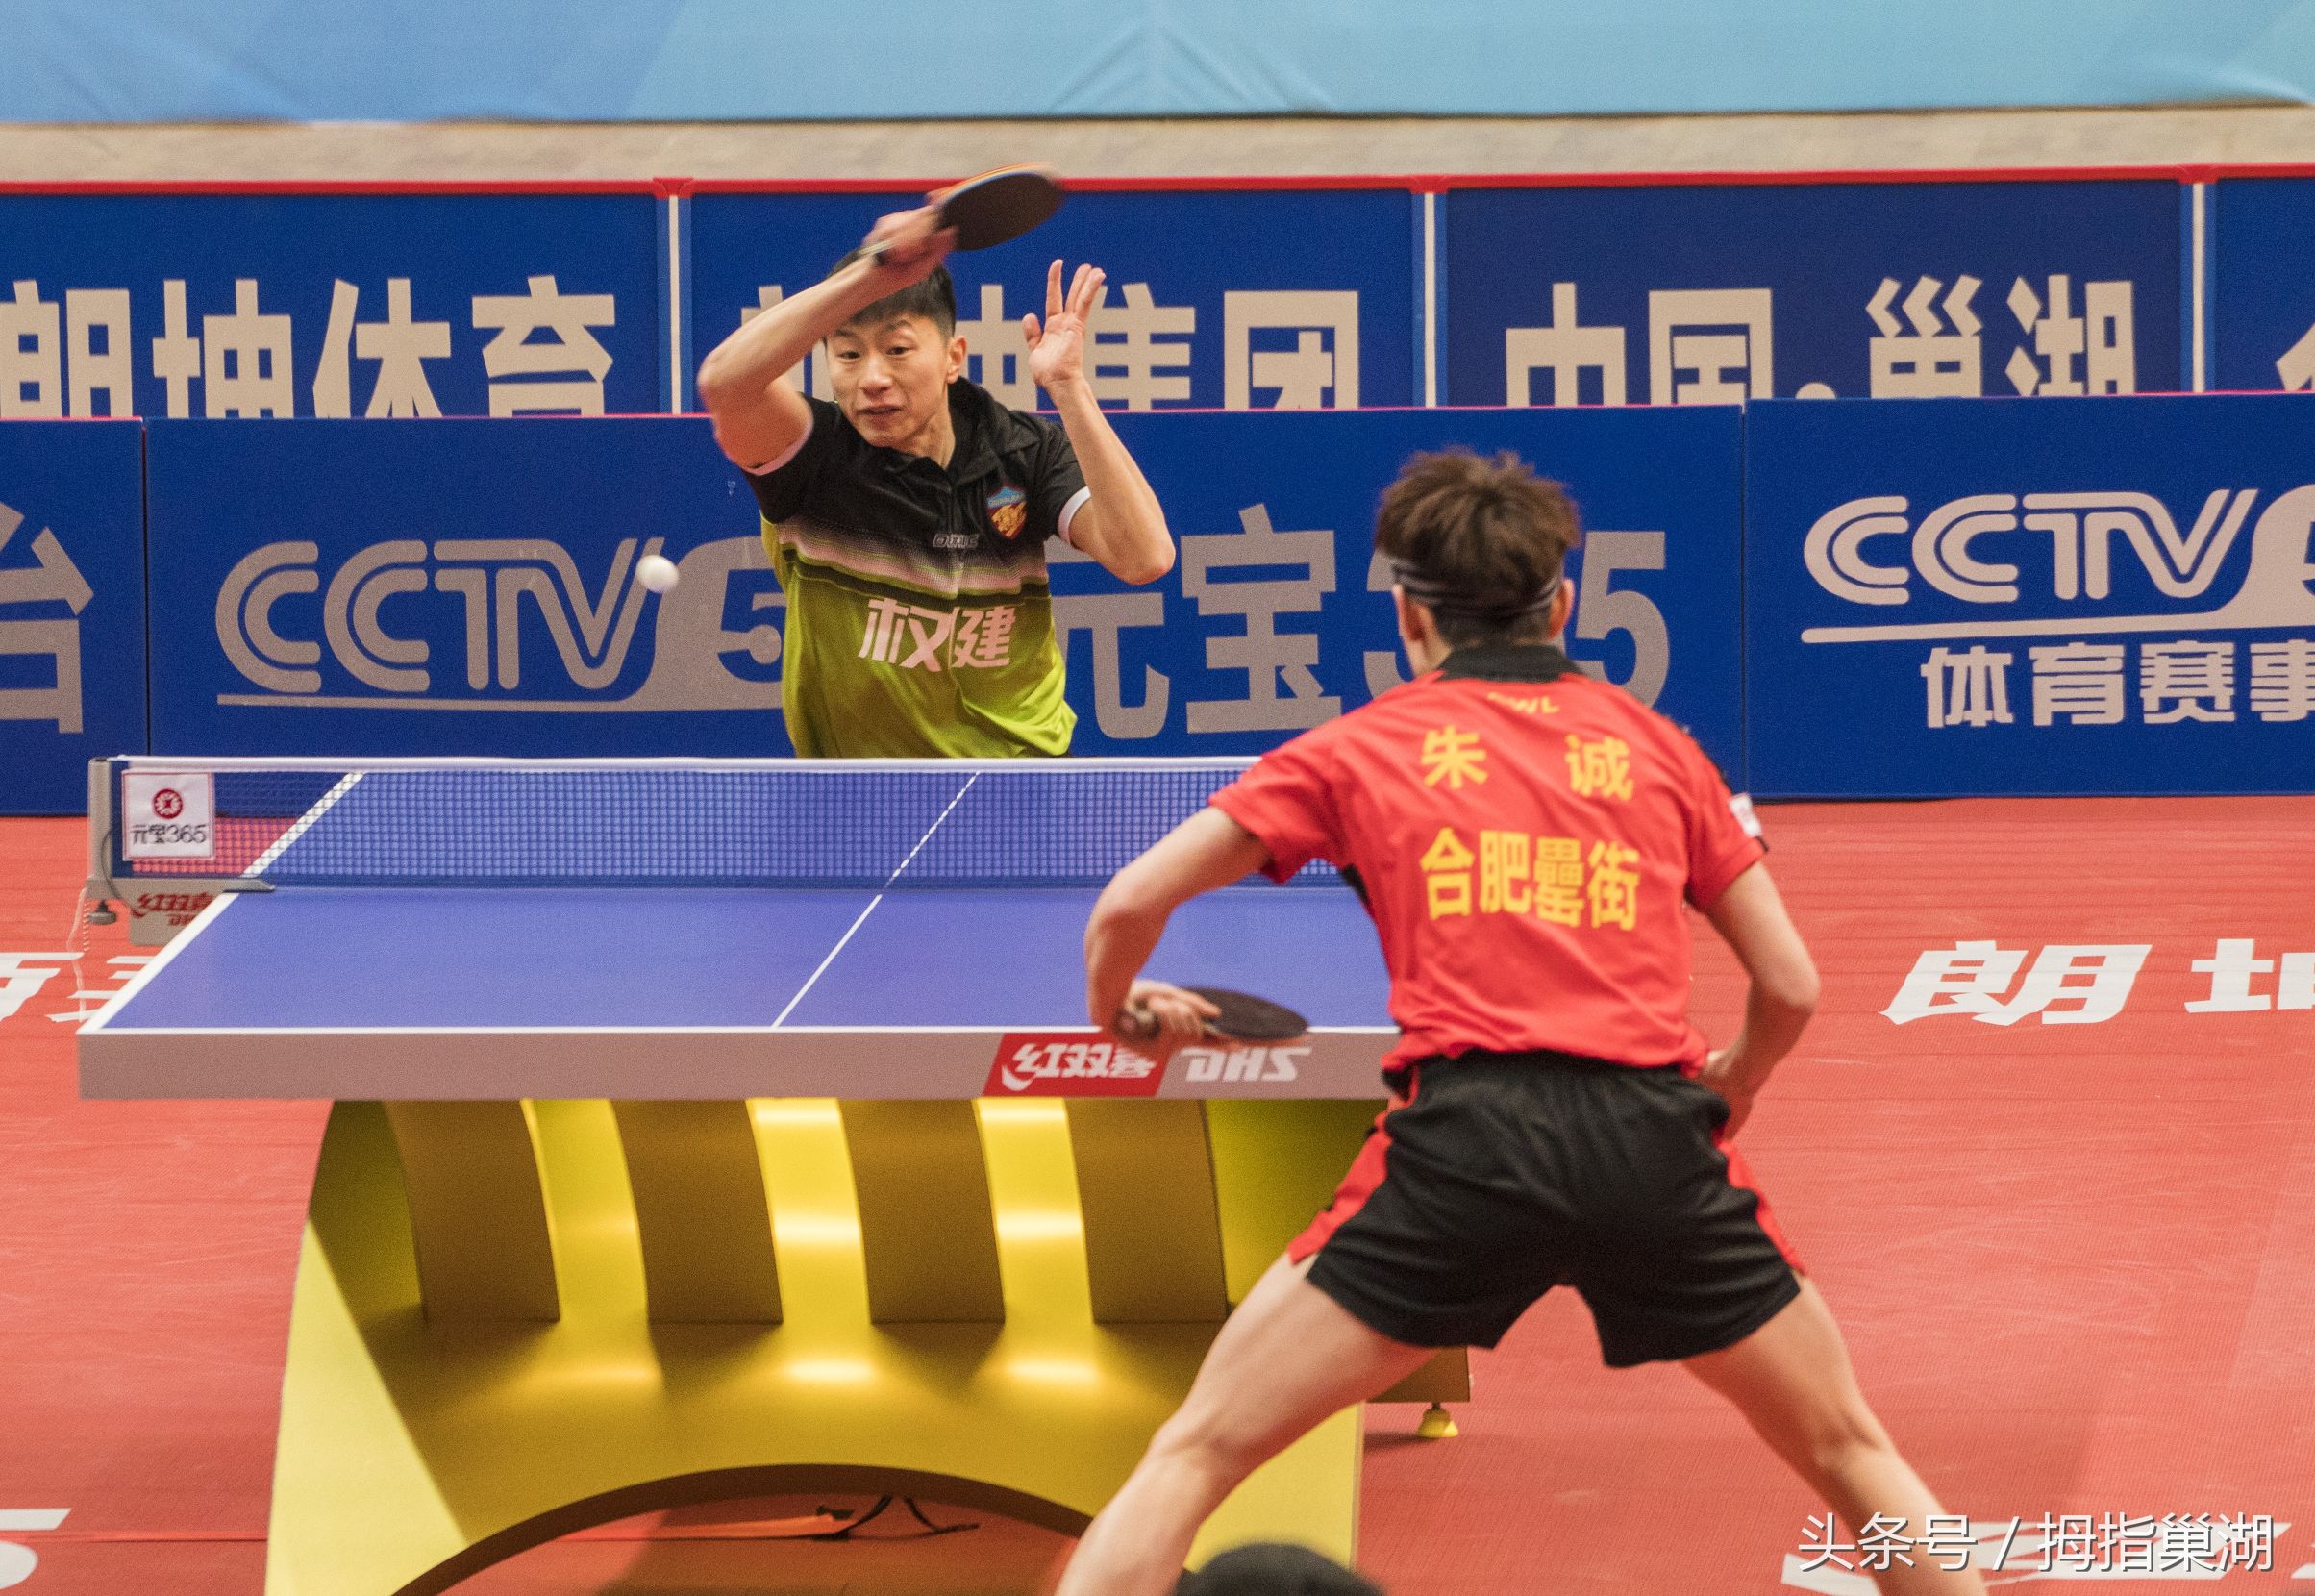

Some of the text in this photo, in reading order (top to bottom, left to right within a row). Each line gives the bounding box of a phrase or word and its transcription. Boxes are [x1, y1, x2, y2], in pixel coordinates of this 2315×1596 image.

[0, 275, 616, 418] 朗坤体育
[1804, 488, 2315, 606] CCTV
[859, 597, 1016, 672] 权建
[1045, 504, 1670, 739] 元宝5
[1921, 639, 2315, 729] 体育赛事
[131, 823, 207, 845] 元宝365
[1420, 827, 1640, 931] 合肥罍街
[1179, 1046, 1312, 1082] DHS
